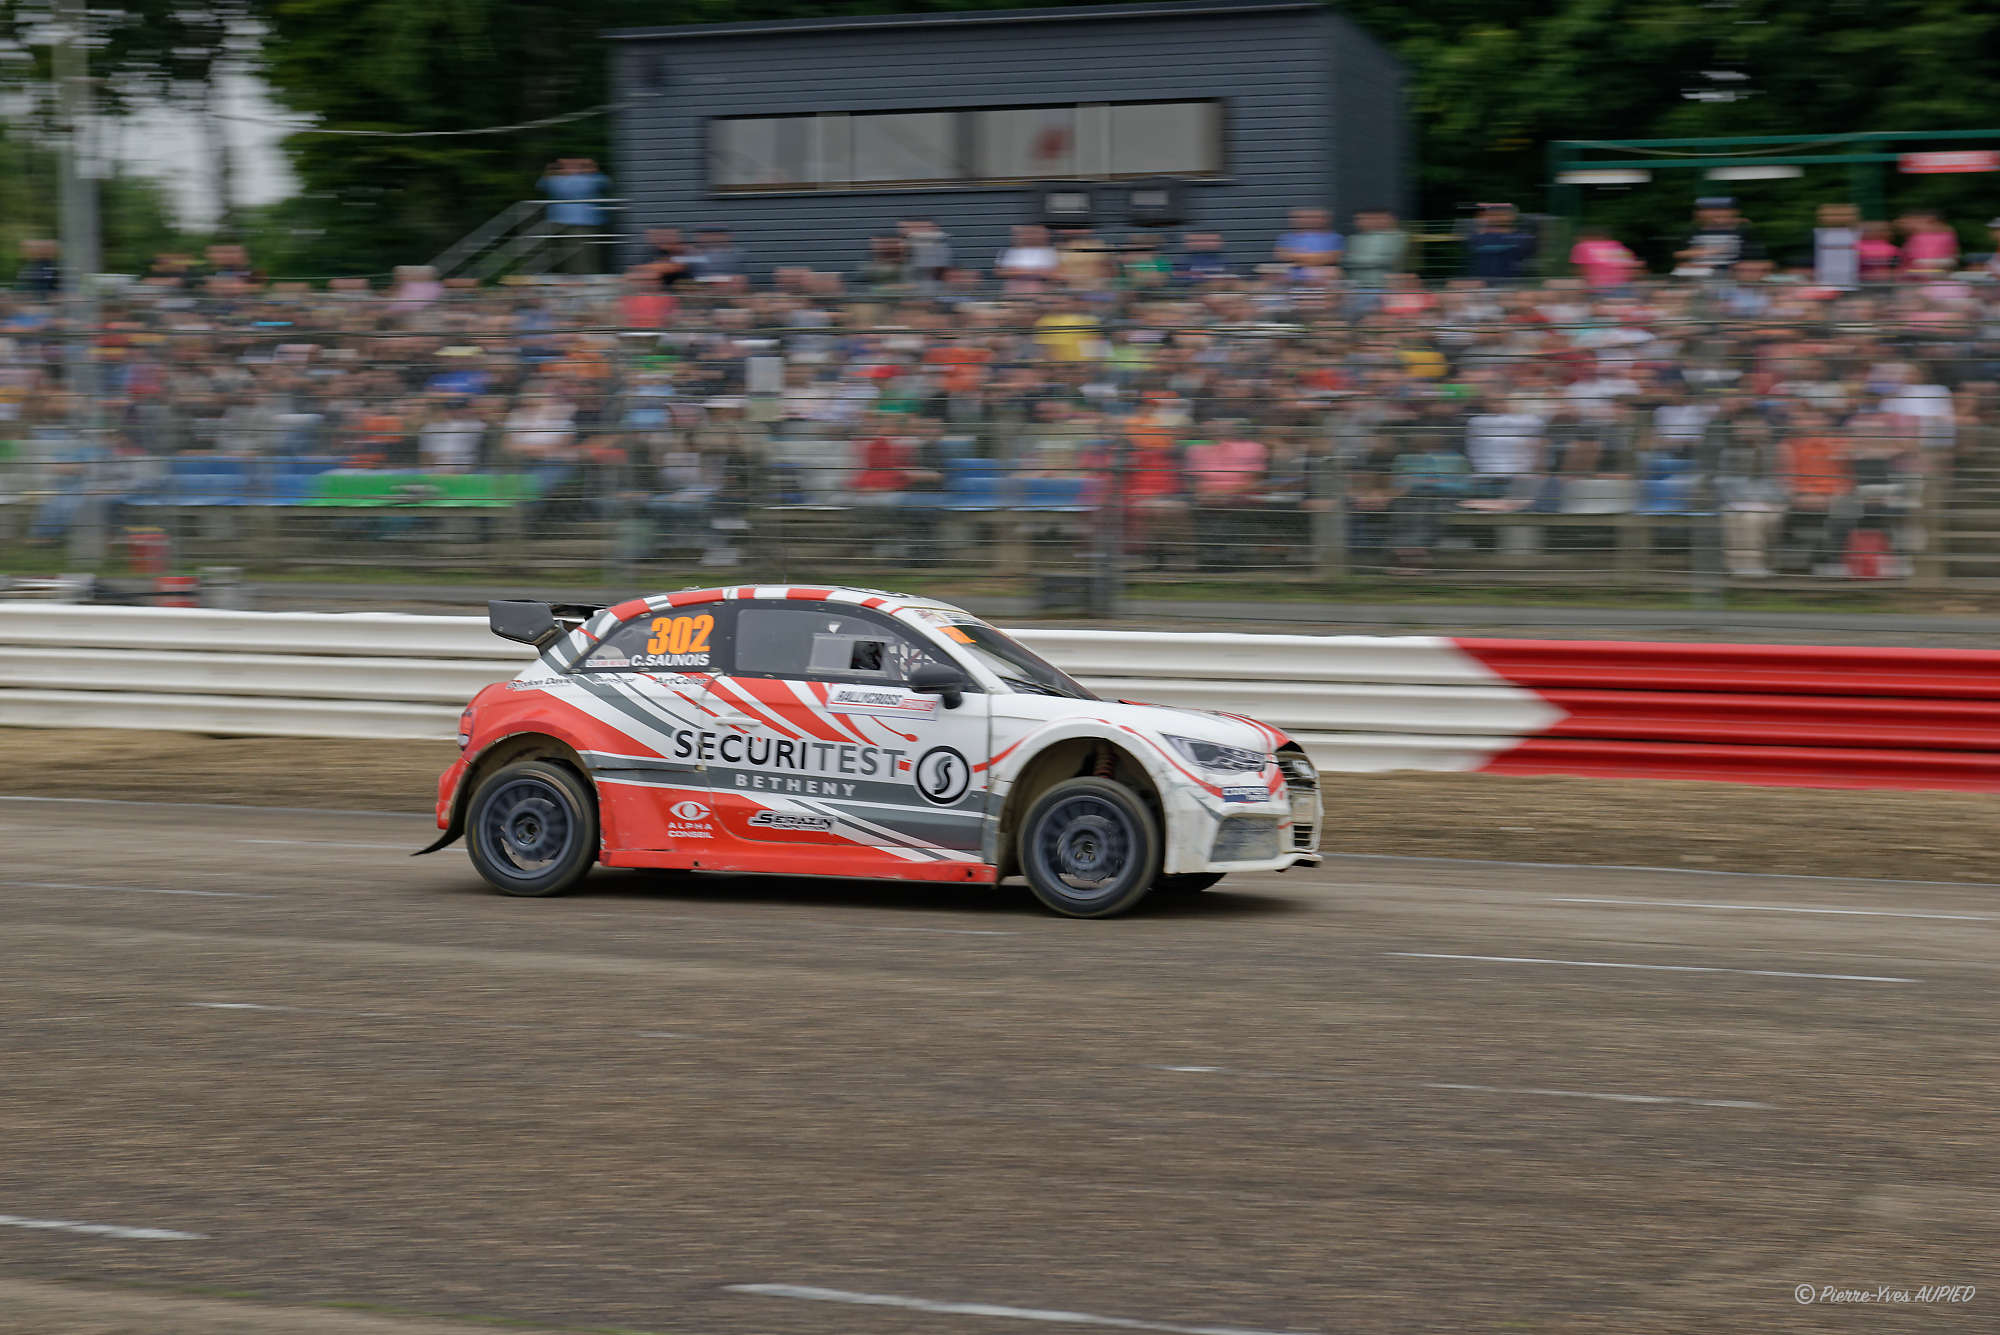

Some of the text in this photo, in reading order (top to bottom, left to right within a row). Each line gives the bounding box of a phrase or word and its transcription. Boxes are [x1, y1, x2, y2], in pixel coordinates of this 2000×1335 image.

[647, 614, 715, 655] 302
[630, 653, 711, 667] C.SAUNOIS
[673, 729, 905, 778] SECURITEST
[735, 773, 857, 797] BETHENY
[667, 821, 713, 830] ALPHA
[667, 830, 714, 839] CONSEIL
